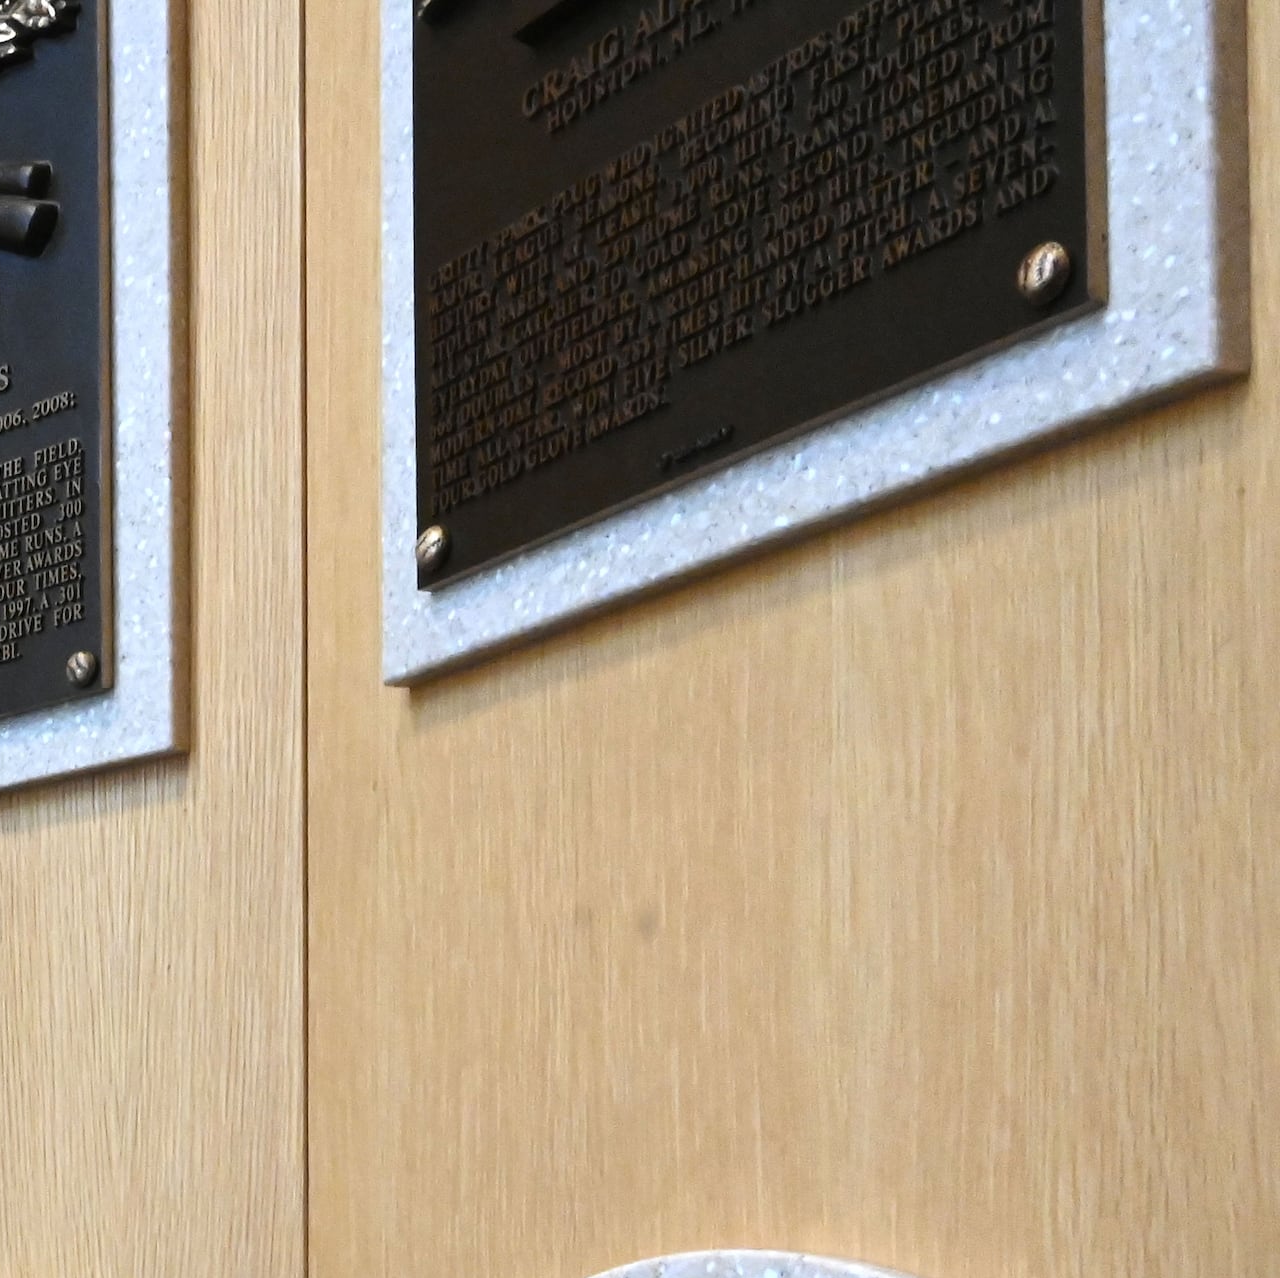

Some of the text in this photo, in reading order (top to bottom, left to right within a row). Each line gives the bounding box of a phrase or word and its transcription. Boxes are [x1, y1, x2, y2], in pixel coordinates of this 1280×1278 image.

[522, 26, 625, 121] CRAIG
[777, 126, 871, 201] SECOND
[882, 53, 1003, 144] BASEMAN
[902, 58, 1055, 165] INCLUDING
[968, 108, 1022, 161] AND
[761, 251, 870, 330] SLUGGER
[881, 194, 982, 270] AWARDS
[996, 158, 1054, 214] AND
[53, 455, 81, 483] EYE
[66, 476, 81, 499] IN
[25, 539, 82, 573] AWARDS
[53, 600, 82, 627] FOR
